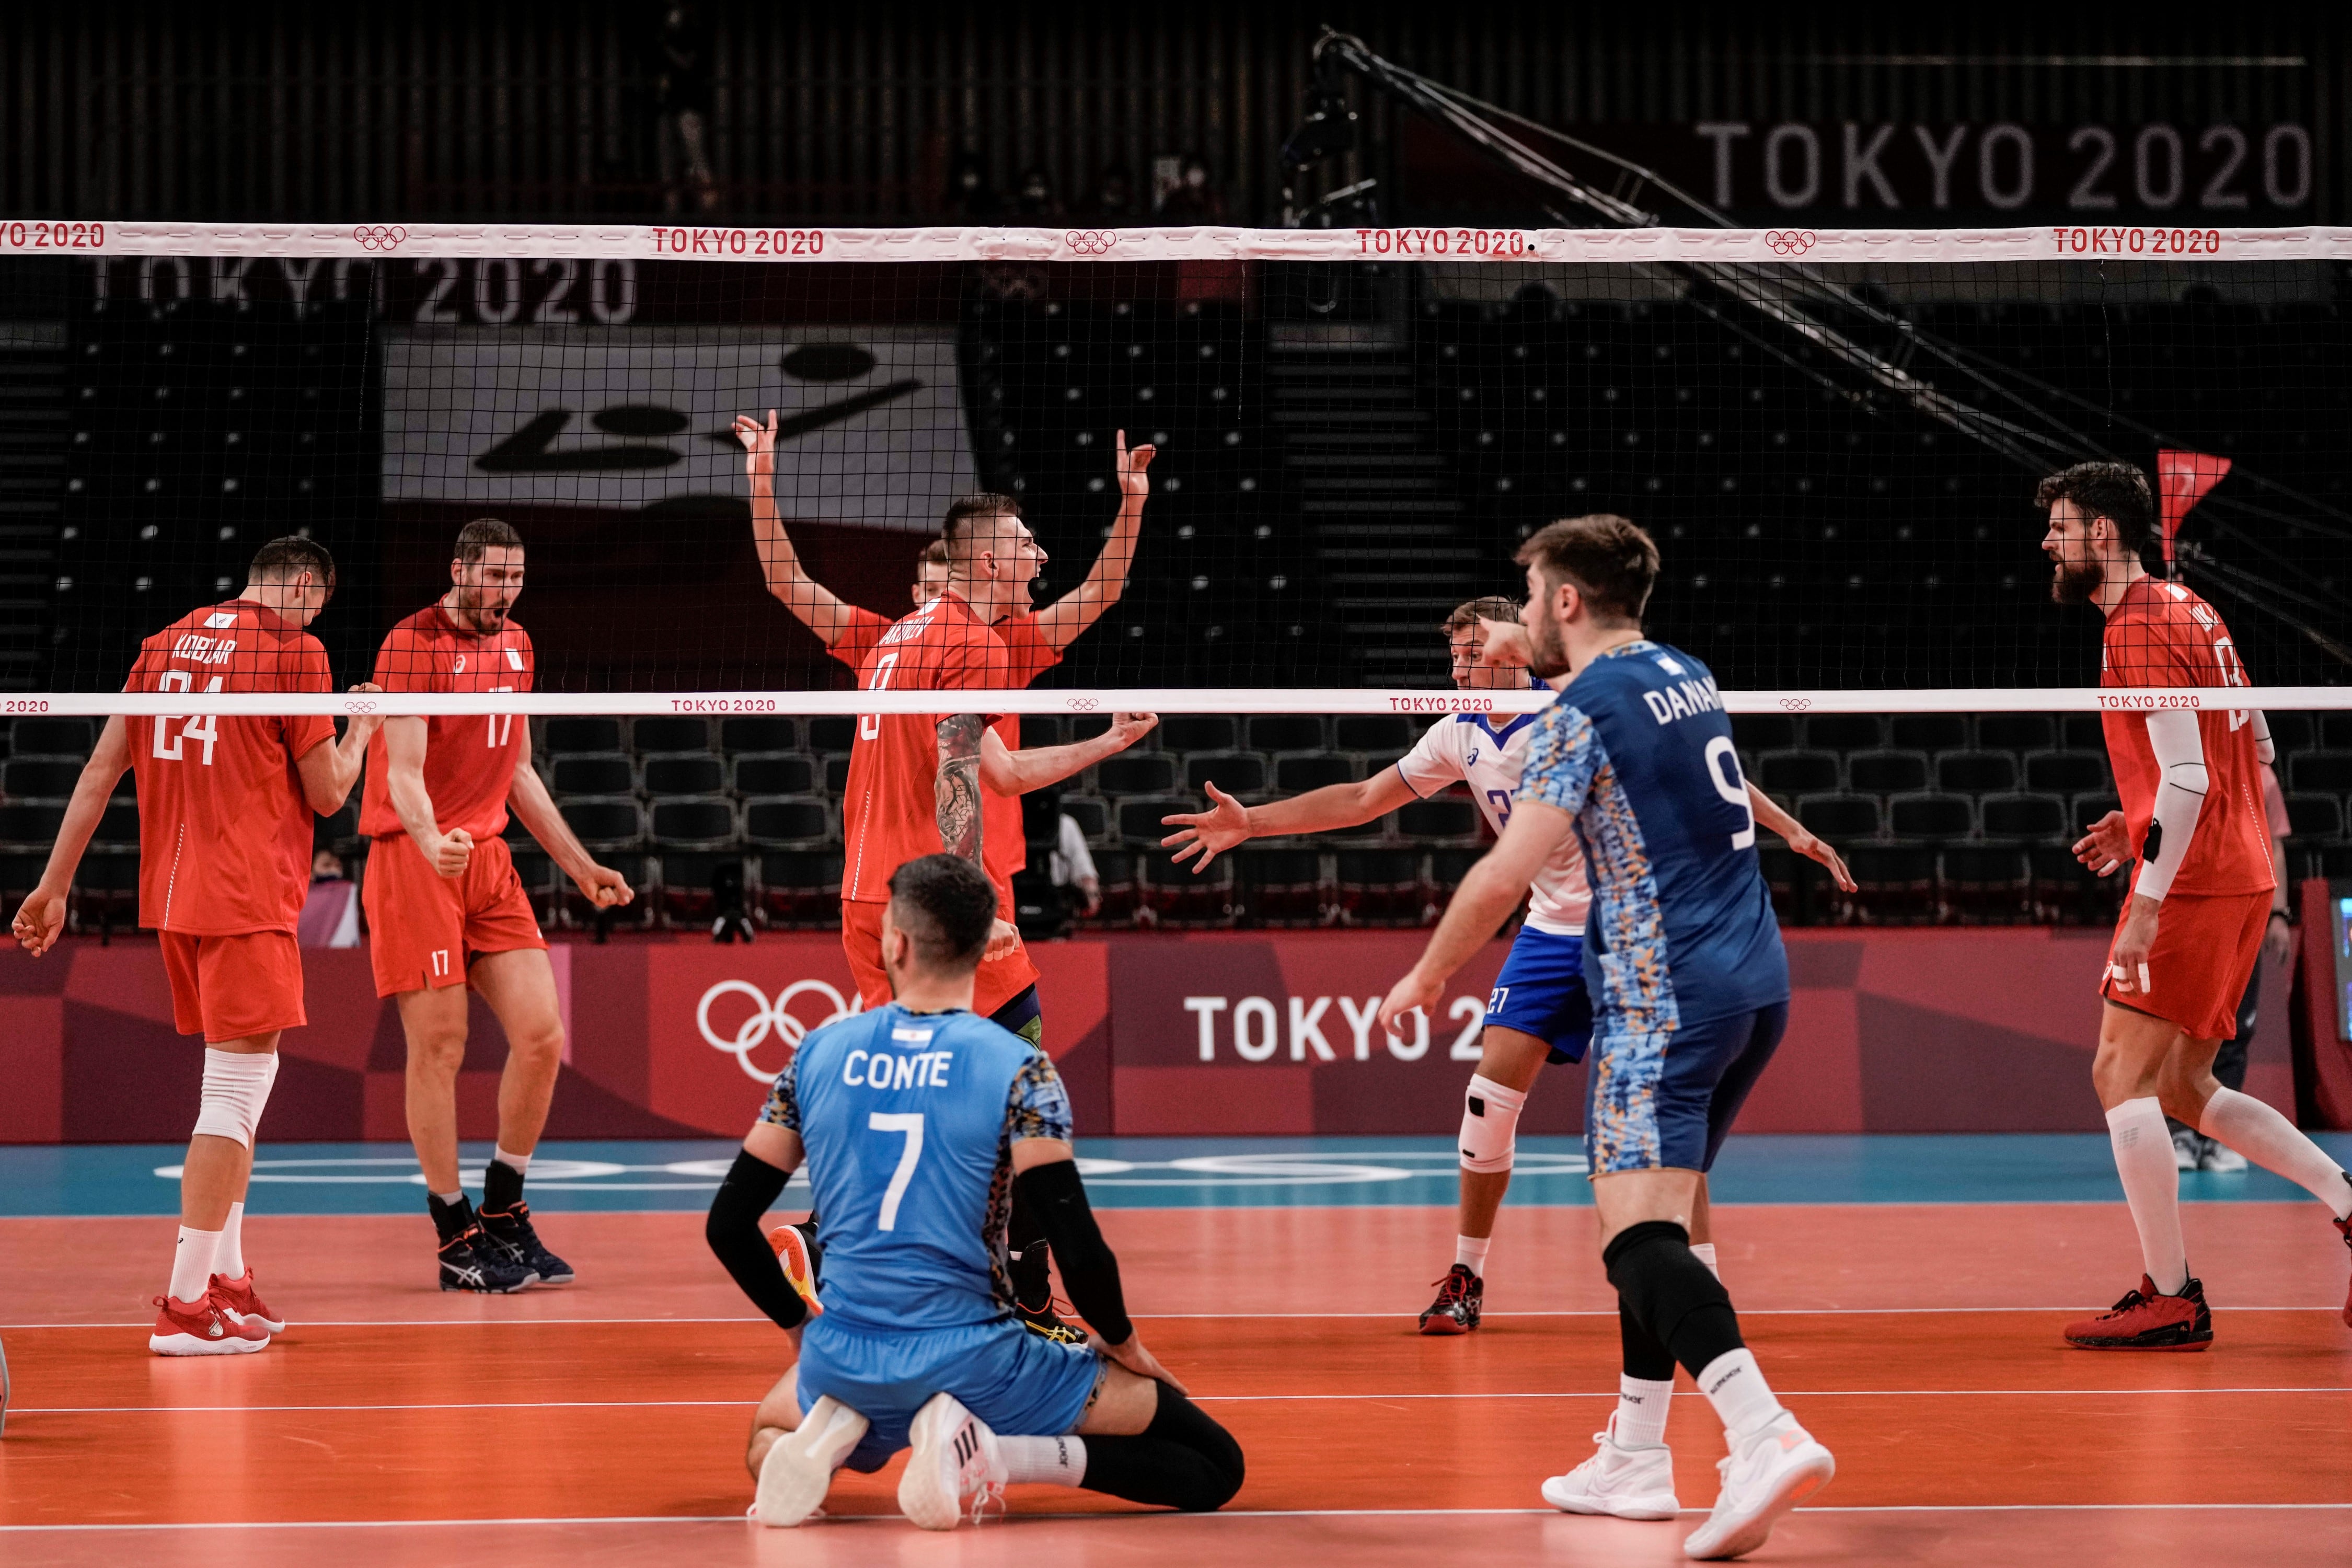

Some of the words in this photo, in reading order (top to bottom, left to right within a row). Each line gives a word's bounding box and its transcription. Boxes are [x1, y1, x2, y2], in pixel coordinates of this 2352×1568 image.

[1697, 124, 2035, 207] TOKYO
[2067, 125, 2312, 207] 2020
[35, 223, 104, 247] 2020
[653, 228, 746, 255] TOKYO
[755, 230, 824, 255] 2020
[1356, 229, 1448, 254] TOKYO
[1457, 230, 1524, 255] 2020
[2054, 228, 2144, 253] TOKYO
[2152, 229, 2220, 253] 2020
[415, 258, 637, 324] 2020
[171, 633, 237, 665] KOBZAR
[6, 700, 49, 712] 2020
[671, 700, 729, 711] TOKYO
[734, 700, 776, 711] 2020
[1390, 698, 1446, 711] TOKYO
[1451, 698, 1493, 711] 2020
[2097, 696, 2154, 708] TOKYO
[2159, 696, 2200, 708] 2020
[153, 669, 223, 766] 24
[488, 686, 513, 748] 17
[1704, 735, 1756, 851] 9
[431, 949, 448, 977] 17
[1486, 986, 1510, 1014] 27
[1183, 996, 1431, 1062] TOKYO
[843, 1050, 953, 1090] CONTE
[868, 1111, 924, 1231] 7
